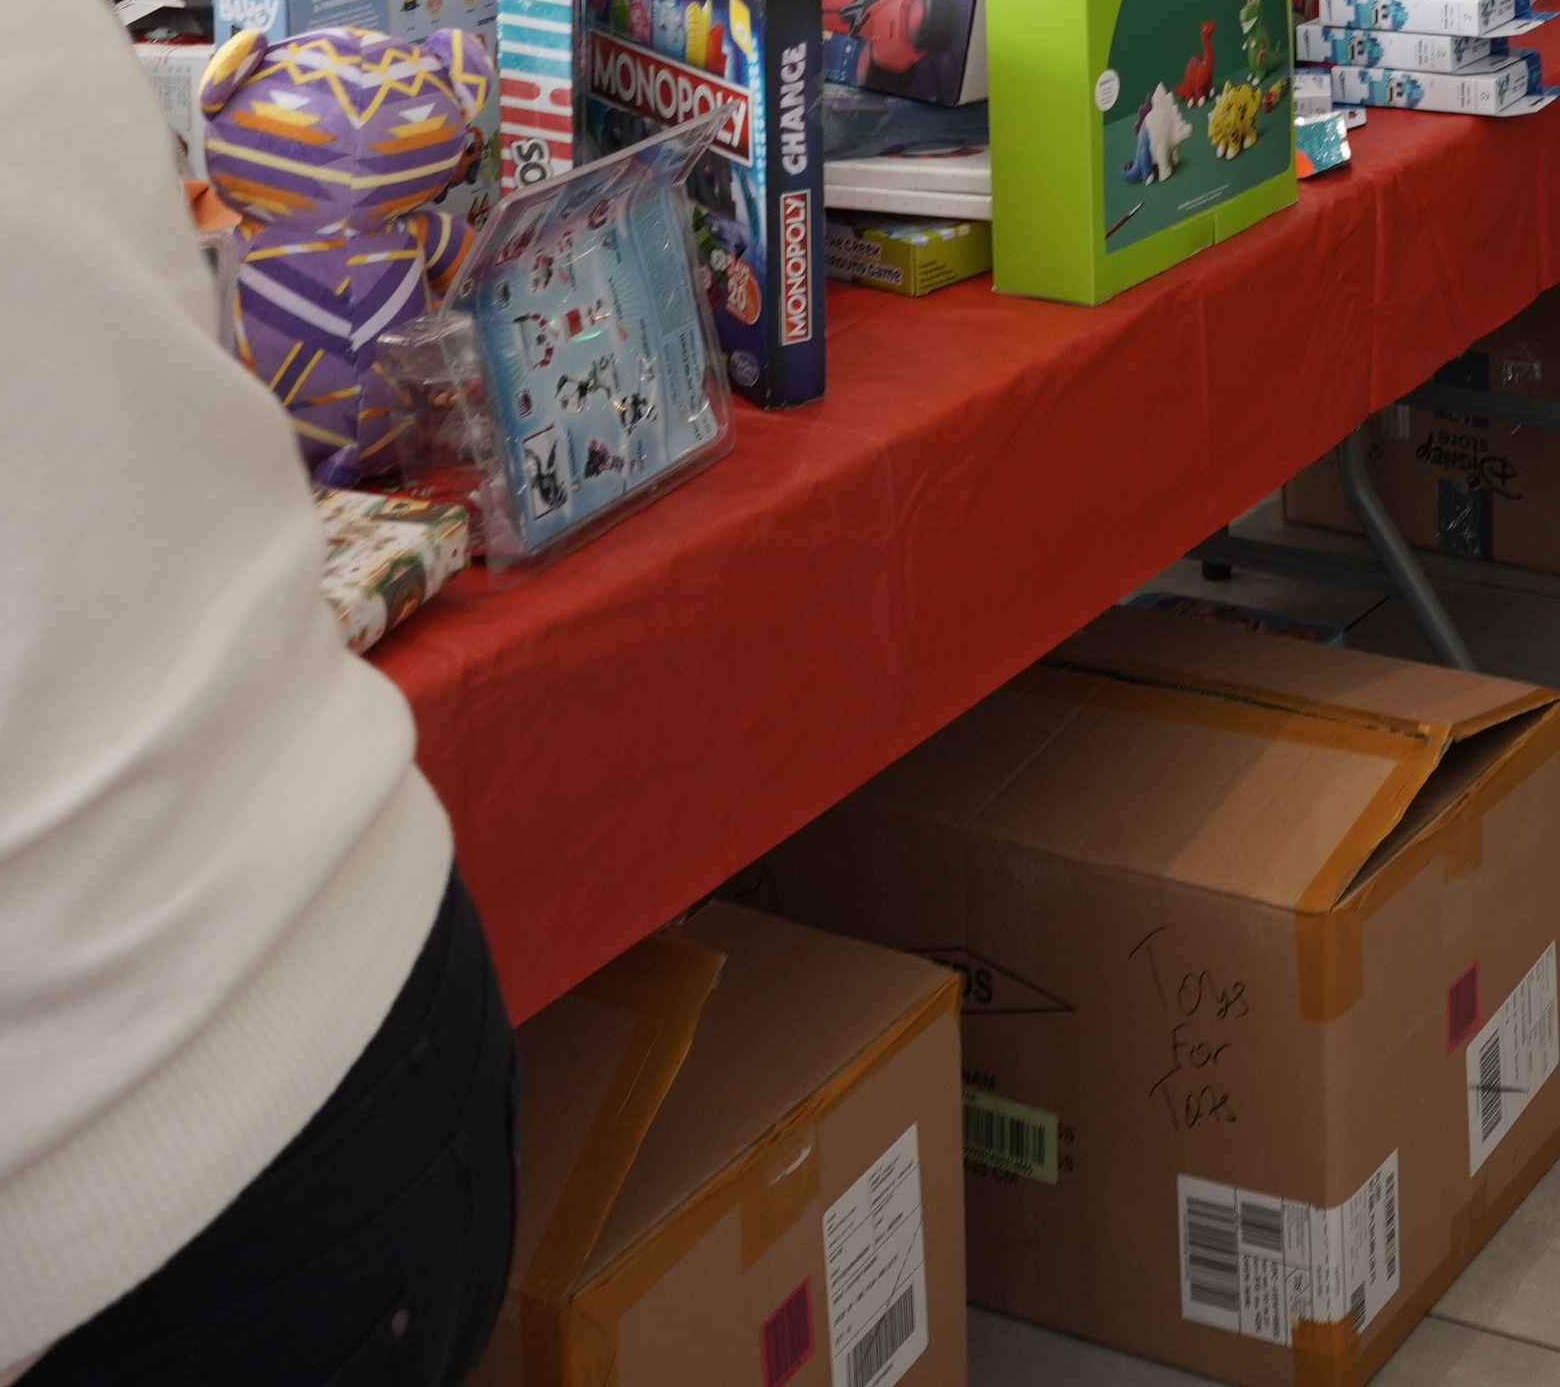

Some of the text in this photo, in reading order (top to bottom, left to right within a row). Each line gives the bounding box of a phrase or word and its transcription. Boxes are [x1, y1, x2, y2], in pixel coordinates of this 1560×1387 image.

[594, 47, 749, 148] MONOPOLY
[781, 41, 808, 176] CHANCE
[784, 197, 809, 340] MONOPOLY
[1129, 925, 1249, 1020] Toys
[1171, 1023, 1232, 1069] For
[1149, 1066, 1237, 1133] Tots
